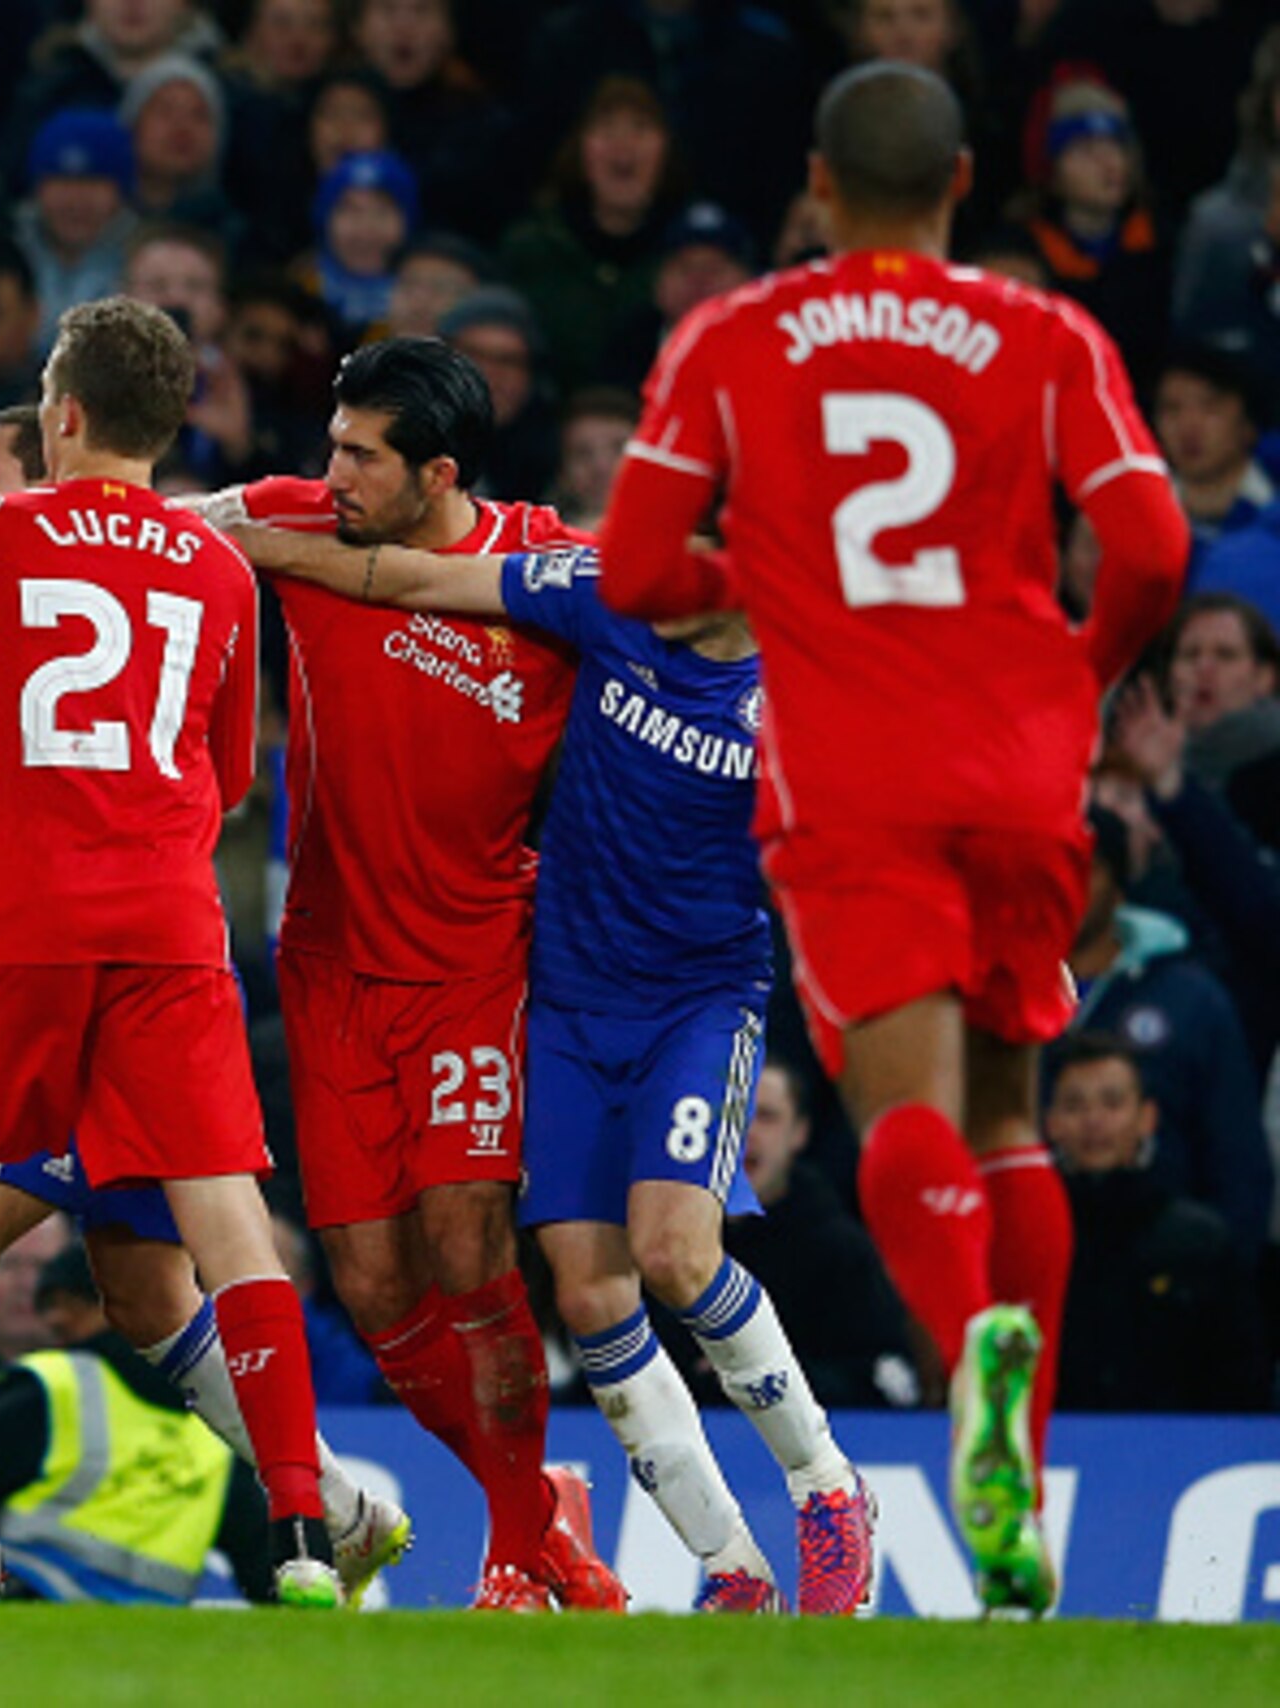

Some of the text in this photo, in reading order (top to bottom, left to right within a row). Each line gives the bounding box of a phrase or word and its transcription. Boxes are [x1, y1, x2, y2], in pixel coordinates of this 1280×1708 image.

[777, 290, 1001, 374] JOHNSON
[34, 509, 202, 563] LUCAS
[821, 392, 966, 606] 2
[19, 578, 203, 780] 21
[599, 678, 760, 781] SAMSUN
[429, 1045, 511, 1125] 23
[666, 1095, 712, 1163] 8
